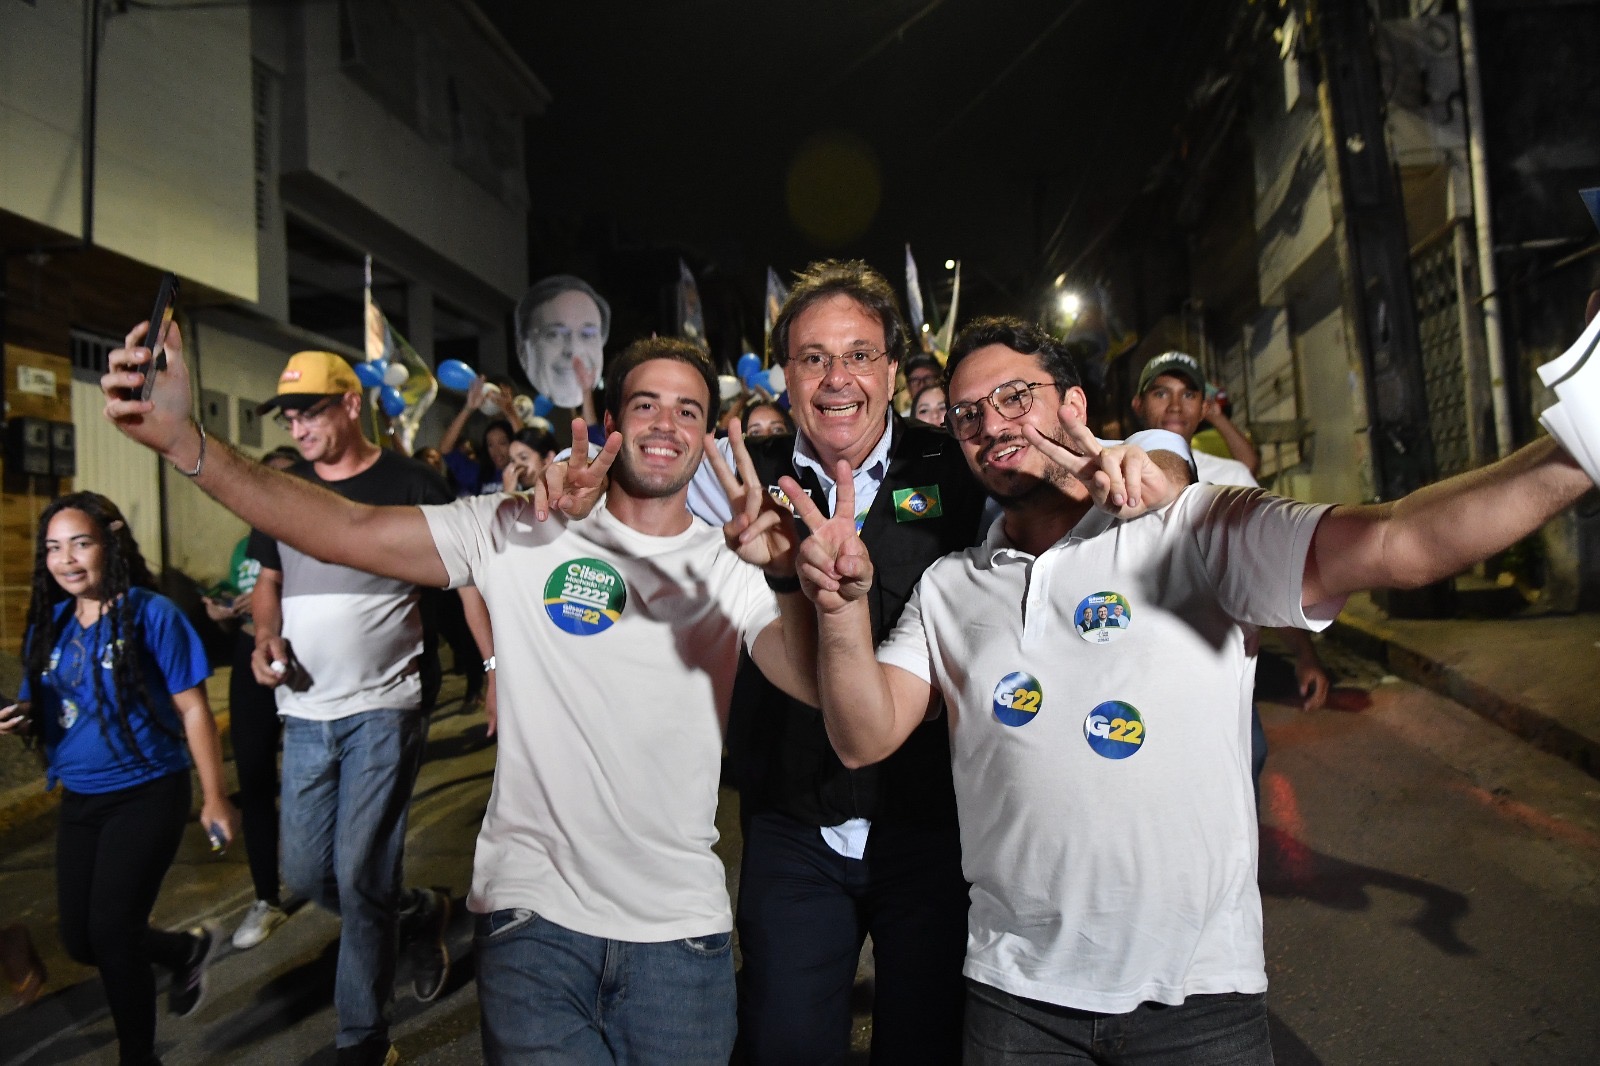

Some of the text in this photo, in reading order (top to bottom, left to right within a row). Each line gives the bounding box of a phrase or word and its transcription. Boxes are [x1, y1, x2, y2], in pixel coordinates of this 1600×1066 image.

[562, 582, 609, 604] 22222
[1104, 594, 1117, 604] 22
[582, 609, 600, 624] 22
[996, 687, 1040, 712] G22
[1090, 714, 1143, 744] G22
